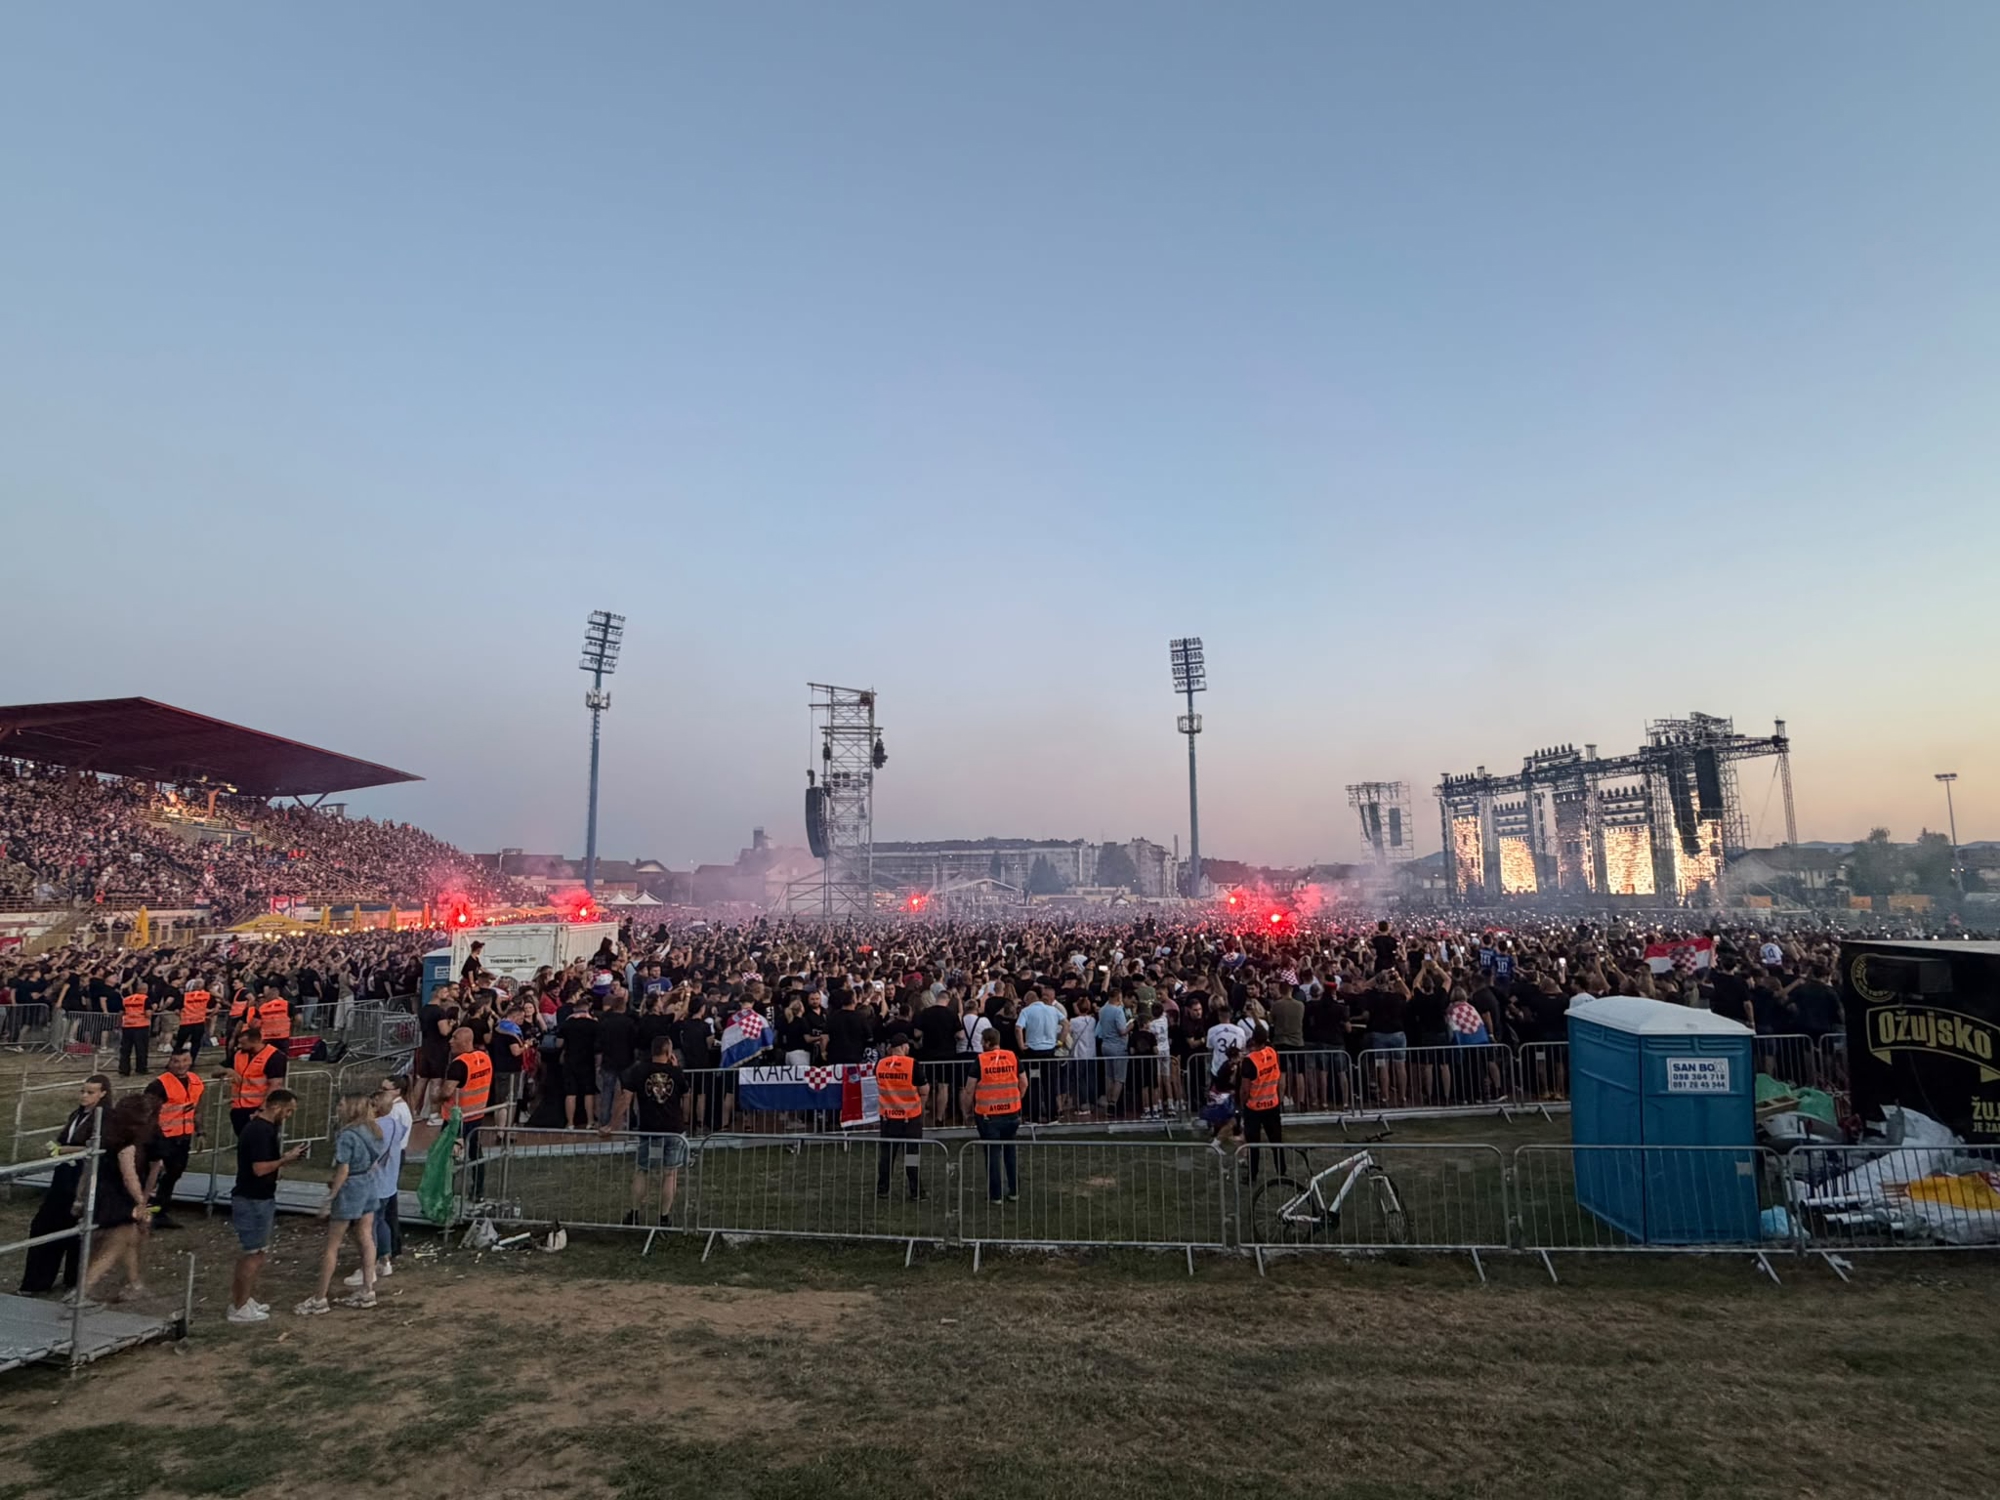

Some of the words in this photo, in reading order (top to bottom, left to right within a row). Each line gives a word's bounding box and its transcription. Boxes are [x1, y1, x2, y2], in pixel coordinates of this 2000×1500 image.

[1878, 1010, 1993, 1060] Ožujsko
[984, 1065, 1015, 1075] SECURITY
[1673, 1063, 1696, 1072] SAN
[878, 1072, 908, 1080] SECURITY
